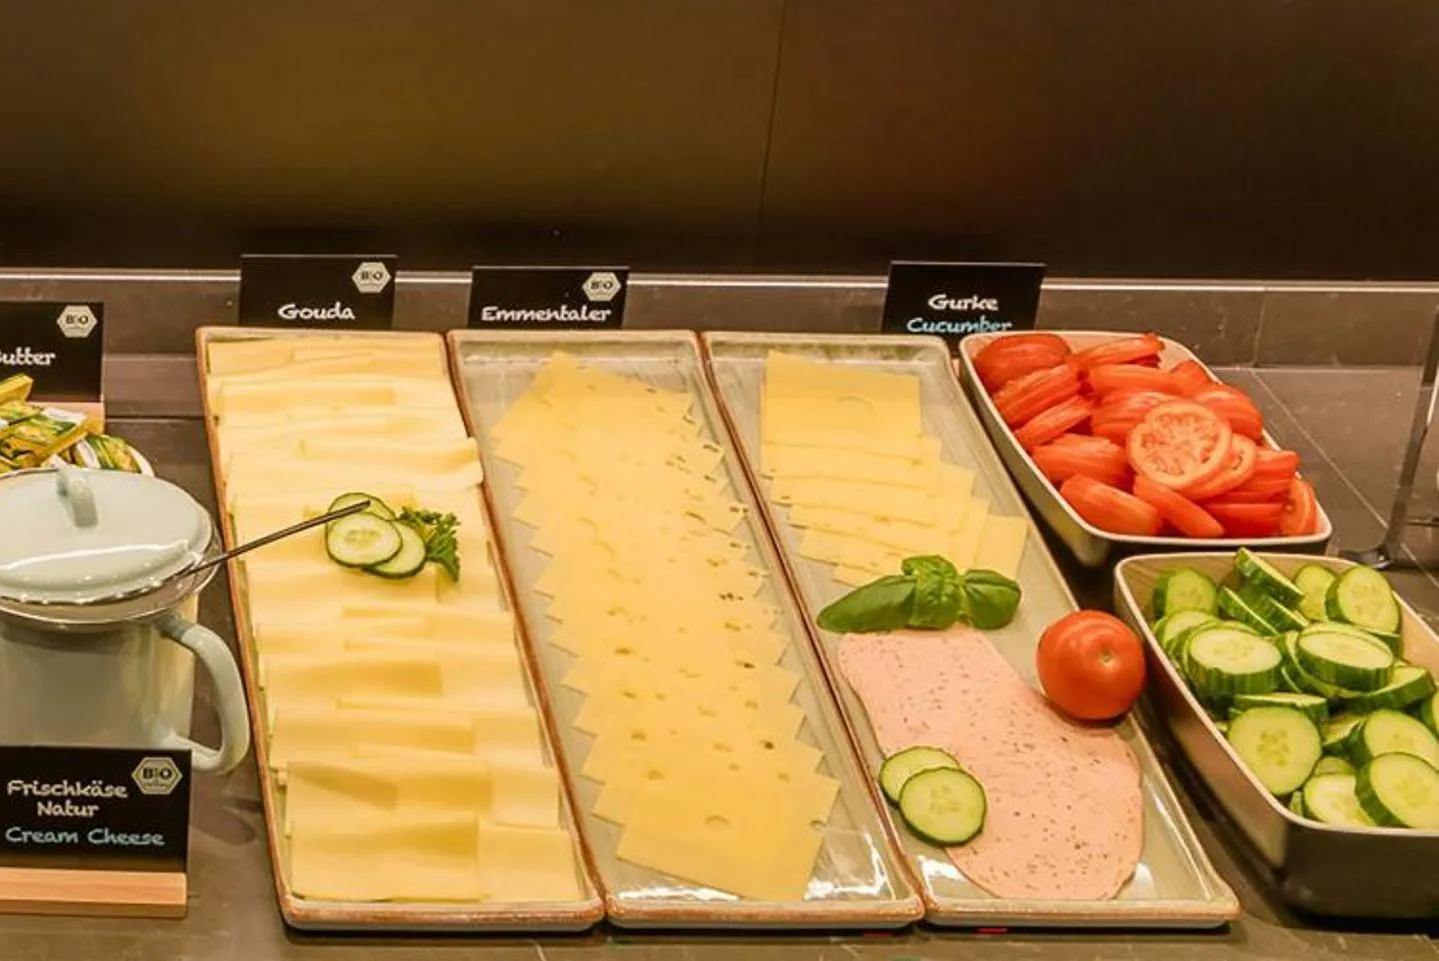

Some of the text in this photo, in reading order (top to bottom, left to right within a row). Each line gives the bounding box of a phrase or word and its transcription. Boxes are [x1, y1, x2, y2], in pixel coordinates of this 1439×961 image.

[277, 302, 356, 321] Gouda
[927, 293, 1000, 312] Gurke
[480, 305, 613, 322] Emmentaler
[906, 315, 1013, 333] Cucumber
[6, 779, 129, 799] Frischkäse
[36, 799, 100, 818] Natur
[4, 826, 166, 846] Cream Cheese
